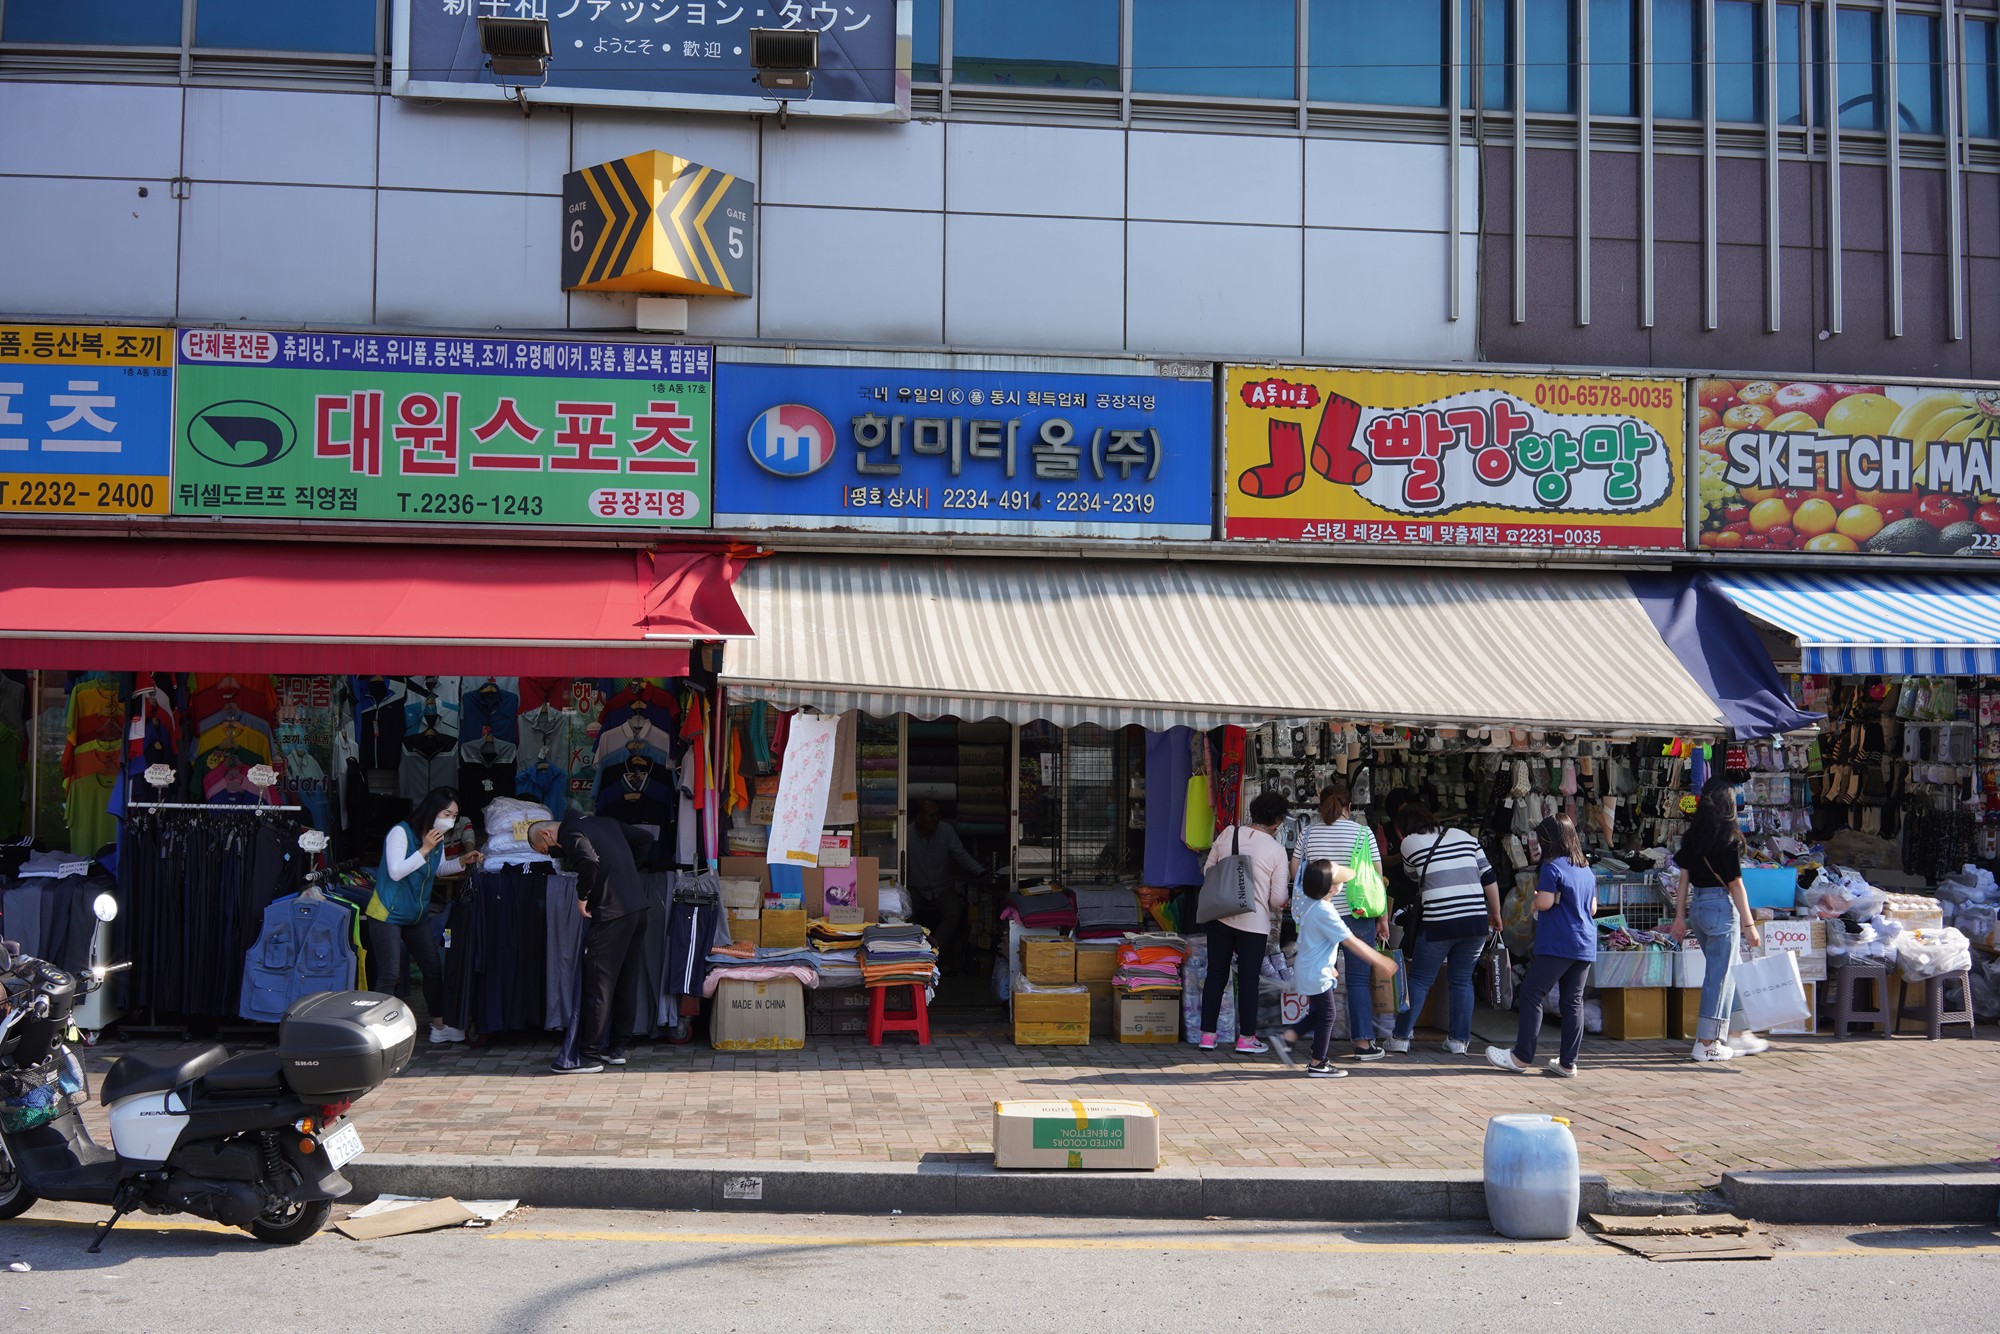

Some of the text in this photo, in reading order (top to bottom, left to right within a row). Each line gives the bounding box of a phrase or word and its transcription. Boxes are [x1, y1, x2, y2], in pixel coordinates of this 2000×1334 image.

[593, 37, 654, 55] ようこそ
[683, 40, 721, 58] 歡迎
[569, 201, 587, 214] GATE
[726, 207, 746, 222] GATE
[570, 219, 584, 252] 6
[728, 226, 744, 259] 5
[189, 332, 270, 360] 단체복전문
[123, 367, 168, 377] 1층 A동 18호
[652, 383, 706, 394] 1층 A동 17호
[1251, 384, 1278, 403] A동
[1535, 383, 1673, 409] 010-6578-0035
[990, 390, 1021, 406] 동시
[1096, 393, 1155, 410] 공장직영
[314, 389, 699, 477] 대원스포츠
[851, 411, 1162, 480] 한미타올(주)
[1723, 430, 1912, 493] SKETCH
[179, 483, 358, 511] 뒤셀도르프 직영점
[397, 492, 543, 515] T.2236-1243
[598, 491, 685, 517] 공장직영
[1056, 491, 1155, 513] 2234-2319
[1301, 522, 1601, 543] 스타킹 레깅스 도매 맞춤제작 2231-0035
[1240, 900, 1247, 908] F.
[1744, 980, 1794, 997] GIORDANO
[731, 999, 786, 1010] MADE IN CHINA
[1053, 1138, 1122, 1147] UNITED COLORS
[1110, 1129, 1122, 1137] OF
